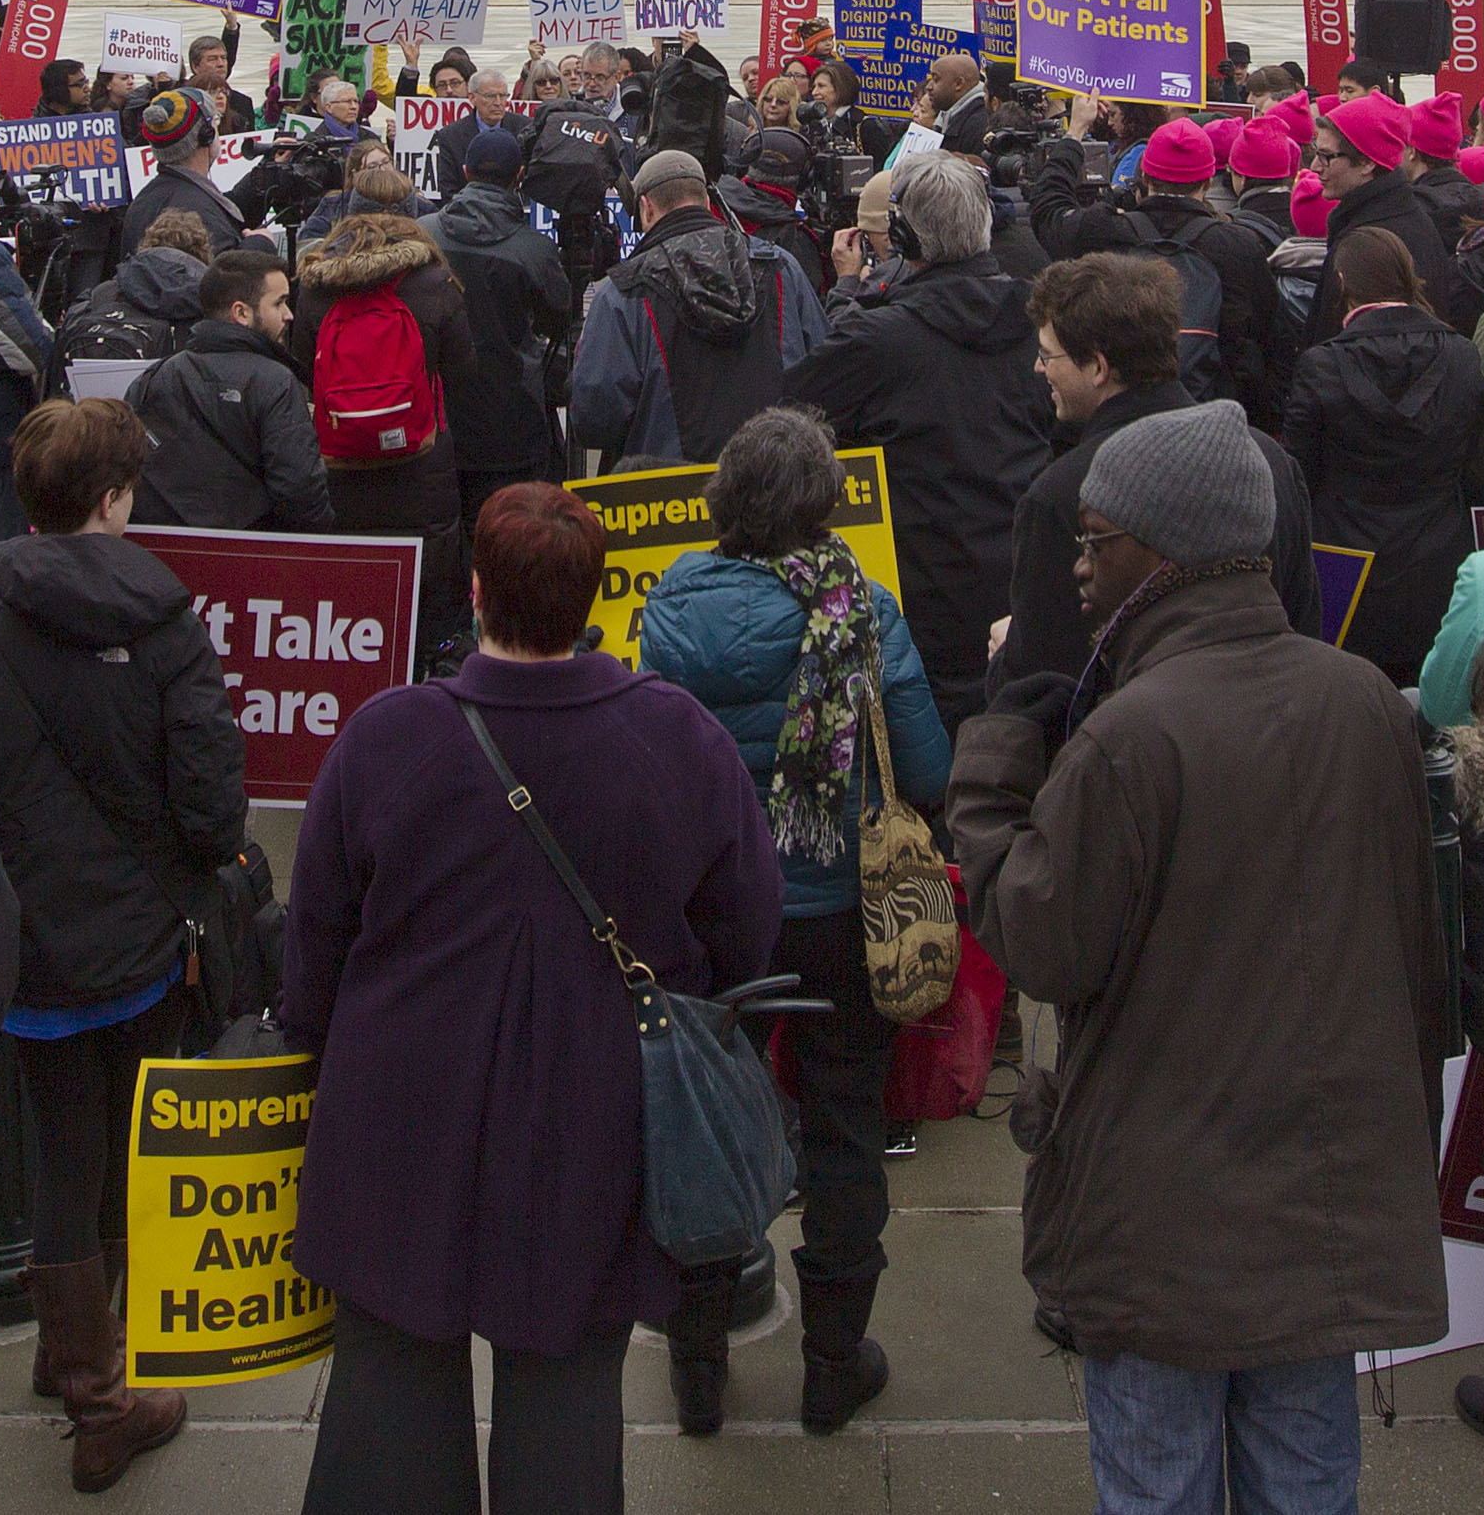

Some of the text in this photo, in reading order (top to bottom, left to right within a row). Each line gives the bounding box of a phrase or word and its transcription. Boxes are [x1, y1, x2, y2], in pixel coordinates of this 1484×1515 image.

[109, 29, 171, 48] #Patients
[364, 19, 457, 45] CARE
[910, 23, 957, 43] SALUD
[1077, 9, 1189, 44] Patients
[108, 42, 179, 64] OverPolitics
[767, 14, 778, 69] HEALTHCARE
[307, 54, 344, 73] MY
[863, 61, 902, 76] SALUD
[1028, 55, 1136, 91] #KingVBurwell
[1161, 86, 1192, 98] SEIU
[55, 121, 80, 139] UP
[83, 117, 116, 136] FOR
[560, 120, 609, 145] LiveU
[247, 598, 385, 664] Take
[225, 673, 340, 737] are
[149, 1088, 316, 1138] Suprem
[193, 1228, 300, 1273] Awa
